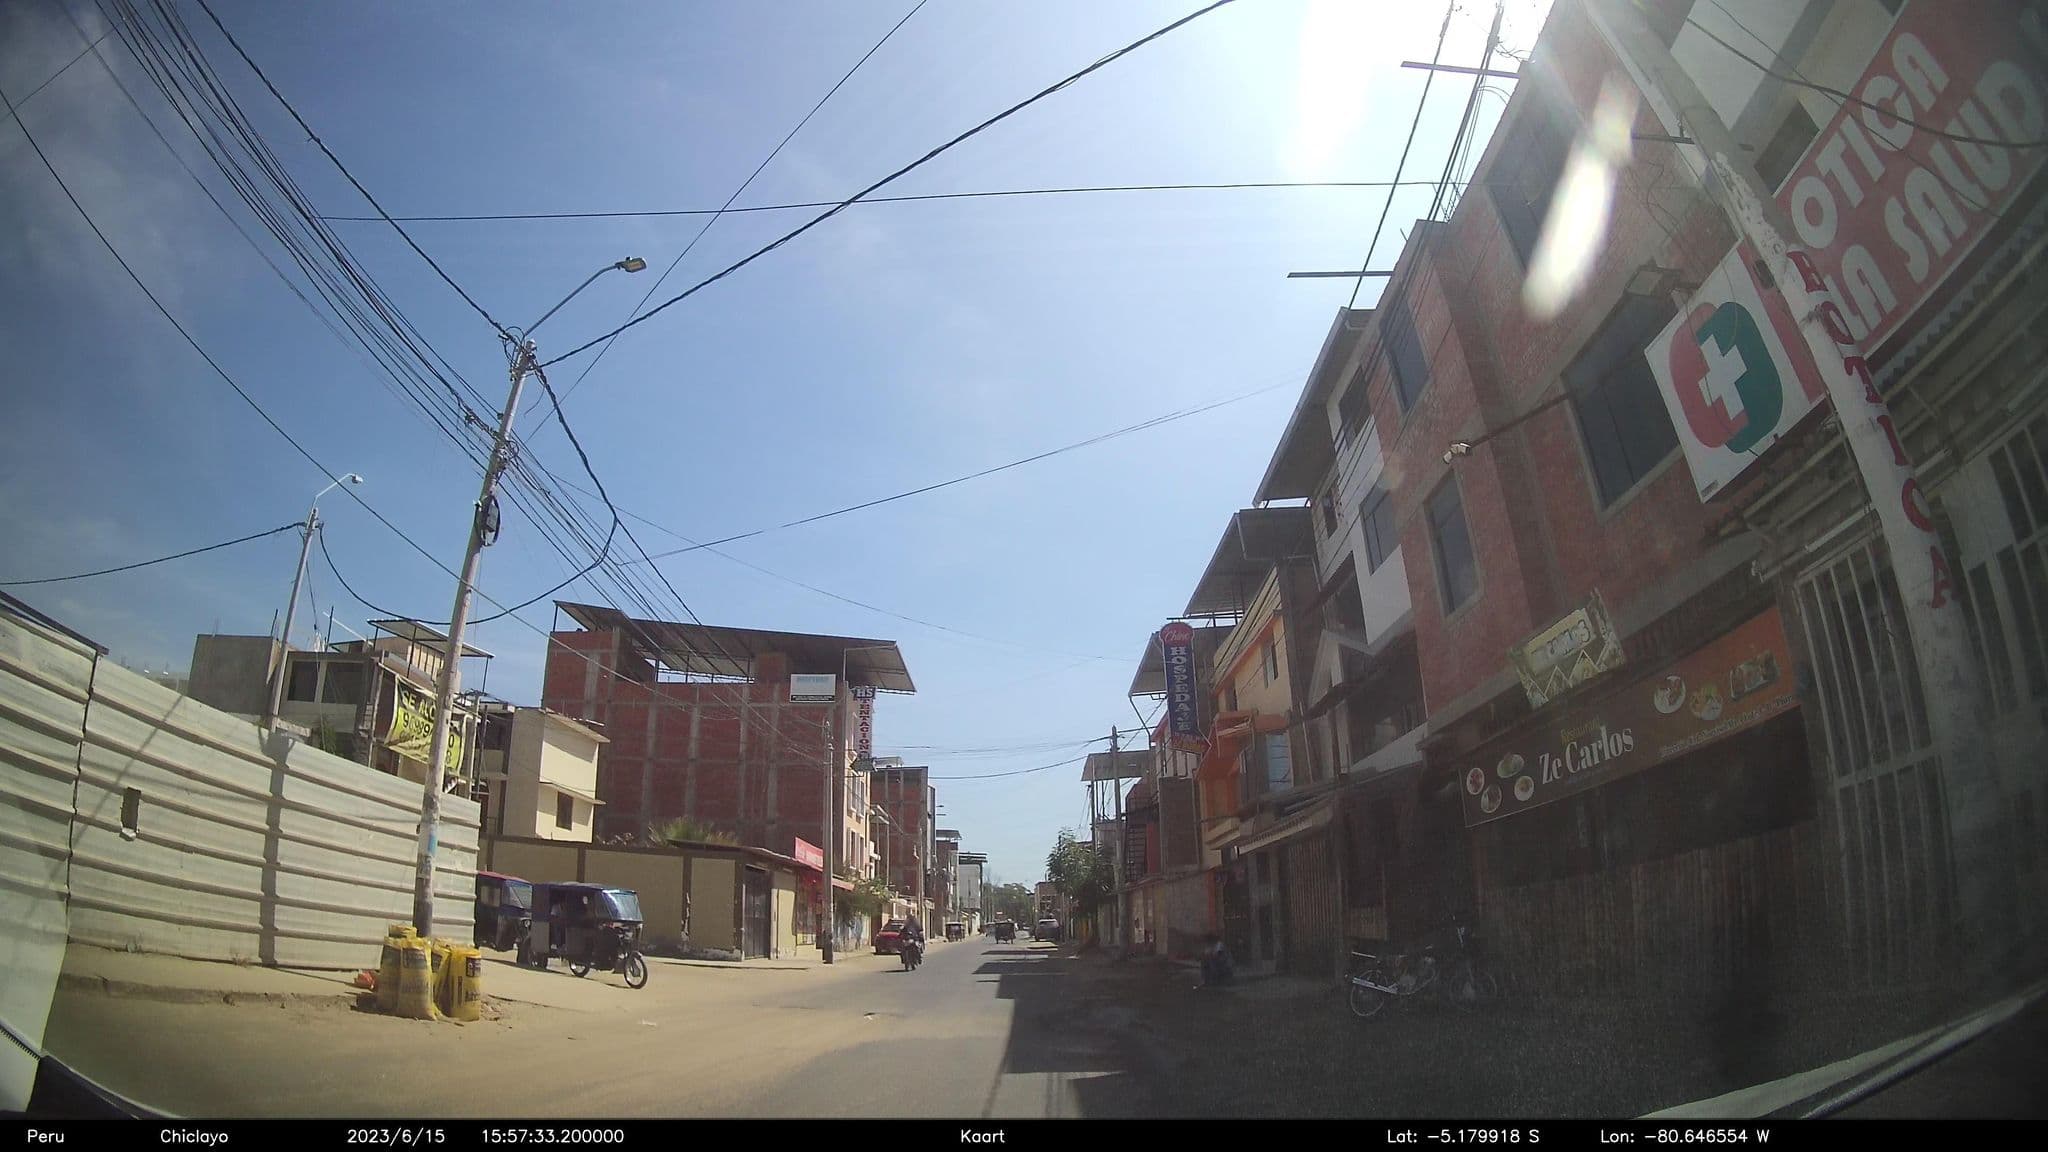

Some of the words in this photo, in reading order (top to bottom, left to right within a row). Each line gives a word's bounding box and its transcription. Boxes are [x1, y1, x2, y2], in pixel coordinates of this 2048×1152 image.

[1791, 32, 1949, 249] OTICA
[1822, 244, 1897, 342] LA
[1884, 60, 2045, 285] SALUD
[401, 689, 417, 706] SE
[856, 687, 874, 698] HS
[1170, 646, 1192, 731] HOSPEDAJE
[1538, 752, 1562, 786] Ze
[1565, 724, 1635, 774] Carlos
